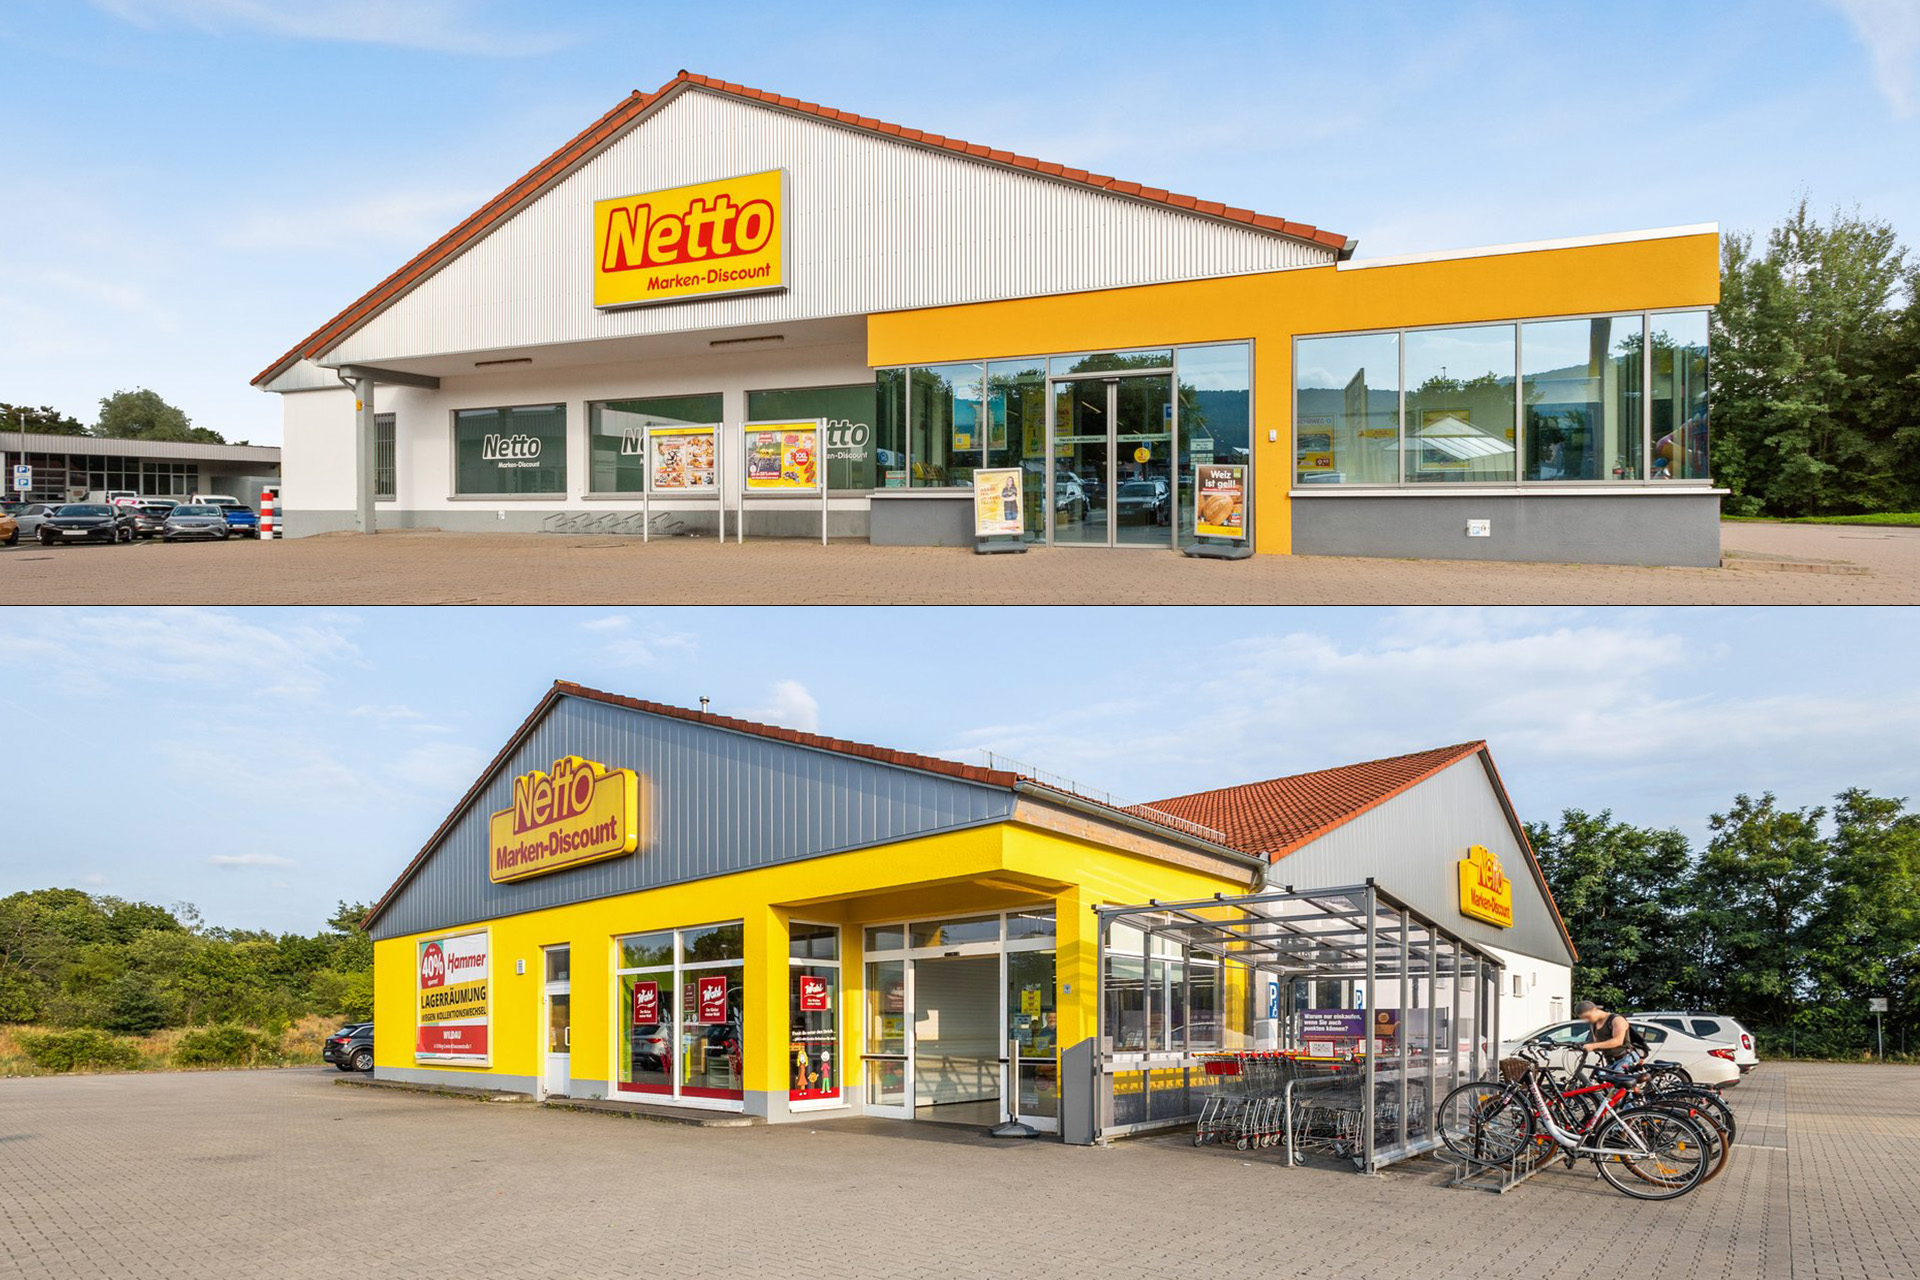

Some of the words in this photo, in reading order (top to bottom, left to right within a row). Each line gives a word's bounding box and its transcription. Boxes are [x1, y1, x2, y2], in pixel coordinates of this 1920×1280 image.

[602, 194, 774, 273] Netto
[647, 263, 770, 291] Marken-Discount
[483, 434, 541, 459] Netto
[827, 420, 869, 448] tto
[827, 451, 868, 459] en-Discount
[1205, 479, 1215, 487] ist
[1217, 479, 1236, 489] geil!
[513, 757, 595, 835] Netto
[496, 815, 617, 870] Marken-Discount
[1477, 846, 1503, 892] Netto
[1471, 888, 1510, 919] Marken-Discount
[422, 953, 444, 978] 40%
[448, 953, 486, 974] Hammer
[421, 986, 486, 1009] LAGERRÄUMUNG
[1270, 985, 1277, 1006] P
[421, 1013, 435, 1021] WEGEN
[437, 1006, 487, 1020] KOLLEKTIONSWECHSEL
